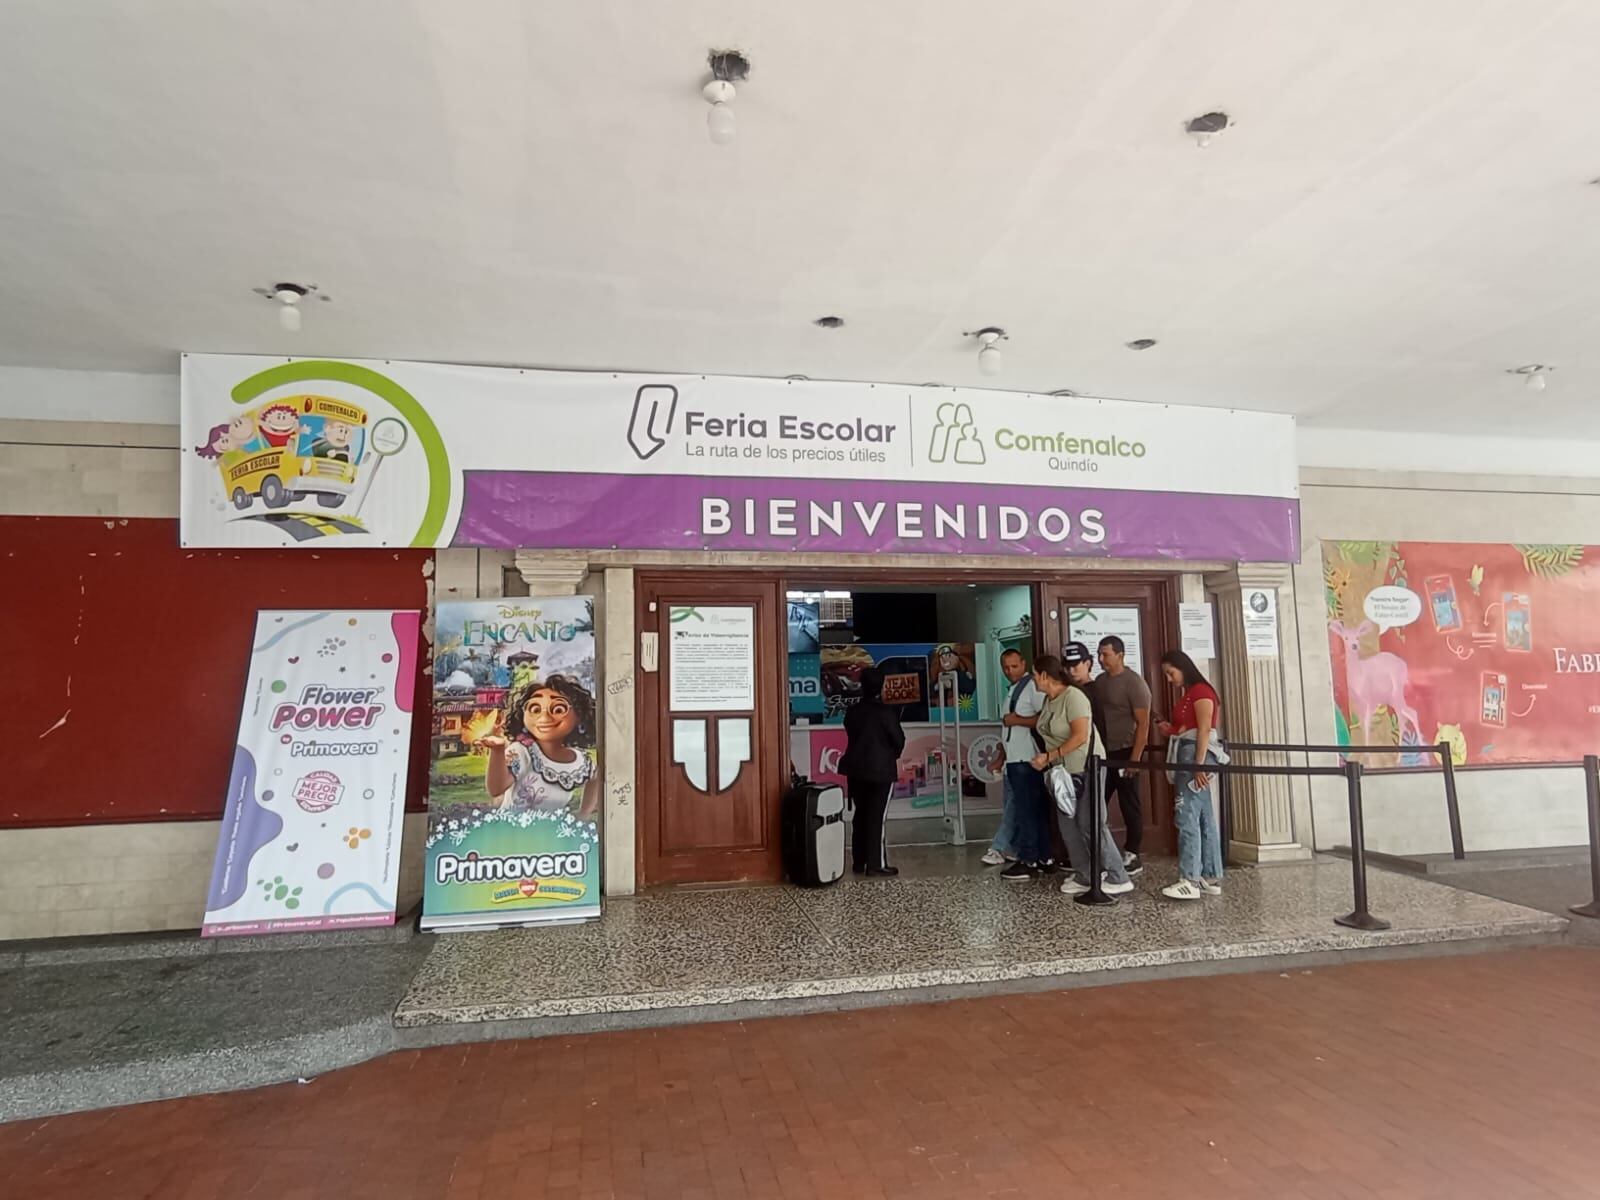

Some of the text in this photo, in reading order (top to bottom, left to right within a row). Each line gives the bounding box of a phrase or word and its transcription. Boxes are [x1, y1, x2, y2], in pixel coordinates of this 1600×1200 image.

[685, 411, 896, 443] Feria Escolar
[686, 442, 886, 464] La ruta de los precios útiles
[994, 428, 1146, 458] Comfenalco
[231, 454, 281, 479] FERIA ESCOLAR
[1048, 457, 1098, 473] Quindío
[702, 498, 1106, 544] BIENVENIDOS
[496, 604, 542, 621] Disney
[464, 619, 577, 647] ENCANTO
[884, 676, 914, 689] JEAN
[302, 686, 376, 706] Flower
[273, 704, 383, 730] Power
[291, 740, 378, 757] Primavera
[297, 788, 336, 802] PRECIO
[302, 780, 338, 794] MEJOR
[438, 852, 585, 882] Primavera
